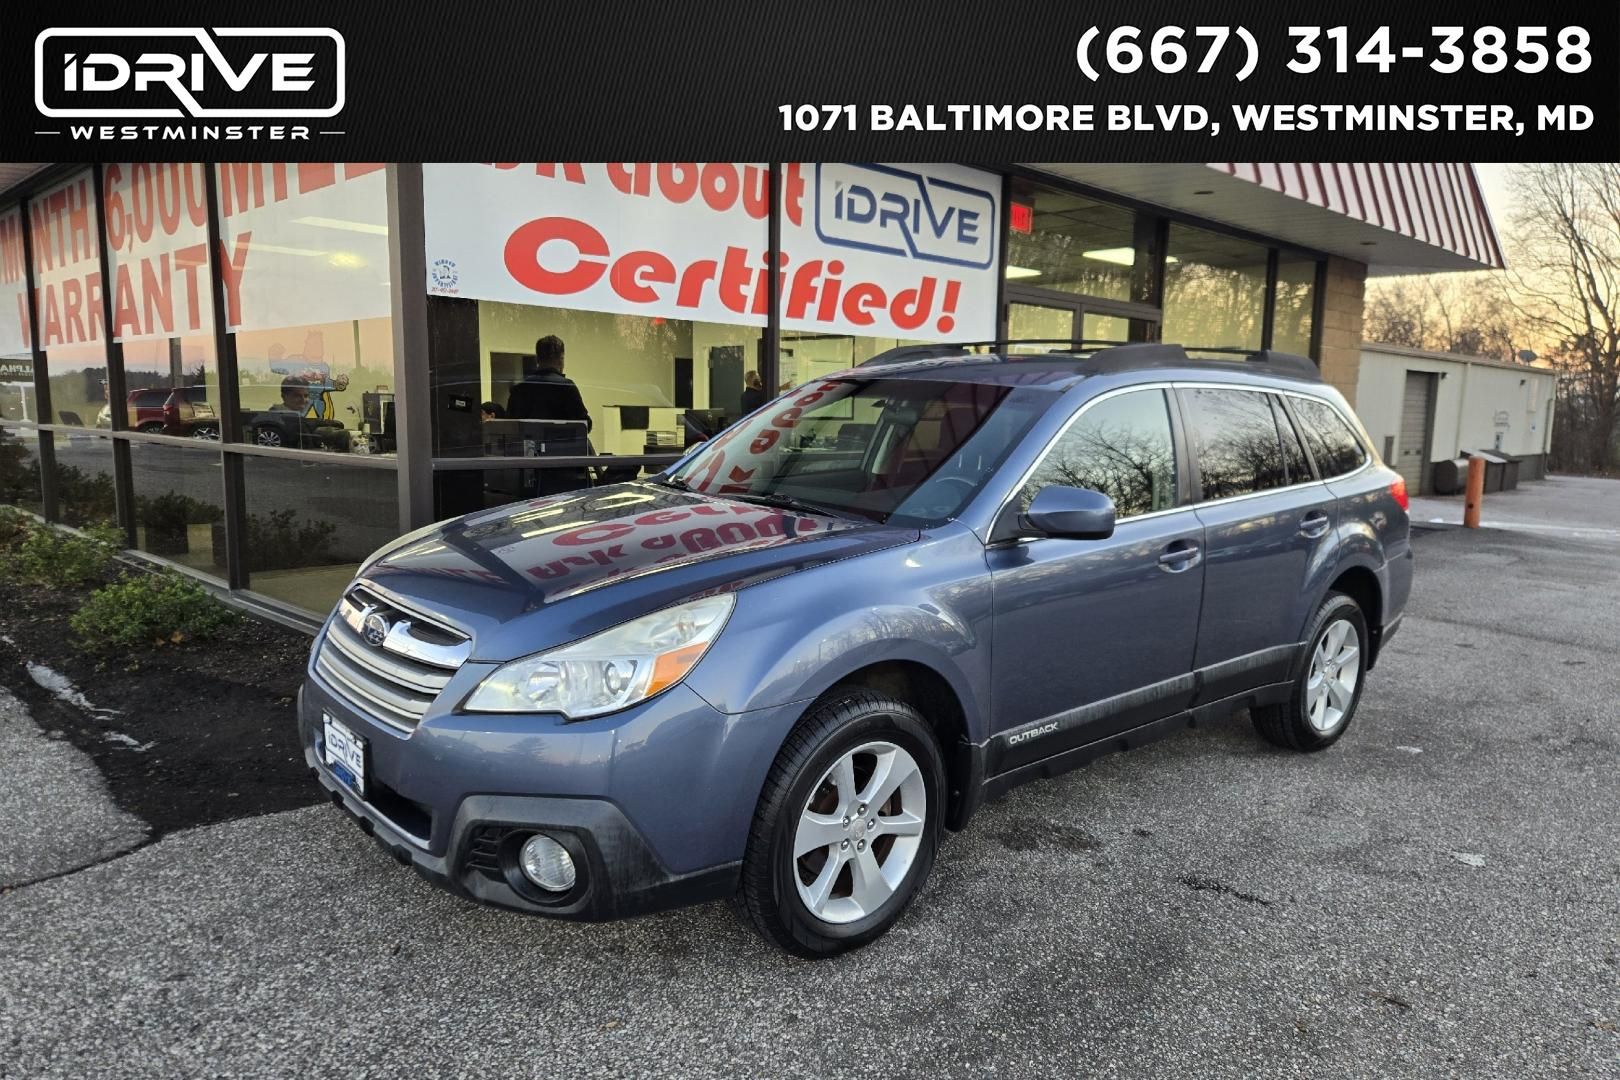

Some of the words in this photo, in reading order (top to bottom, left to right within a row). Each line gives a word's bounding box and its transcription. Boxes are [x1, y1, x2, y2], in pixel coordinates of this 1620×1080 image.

[17, 231, 252, 348] WARRANTY
[503, 216, 962, 334] Certified!
[1009, 721, 1059, 745] OUTBACK
